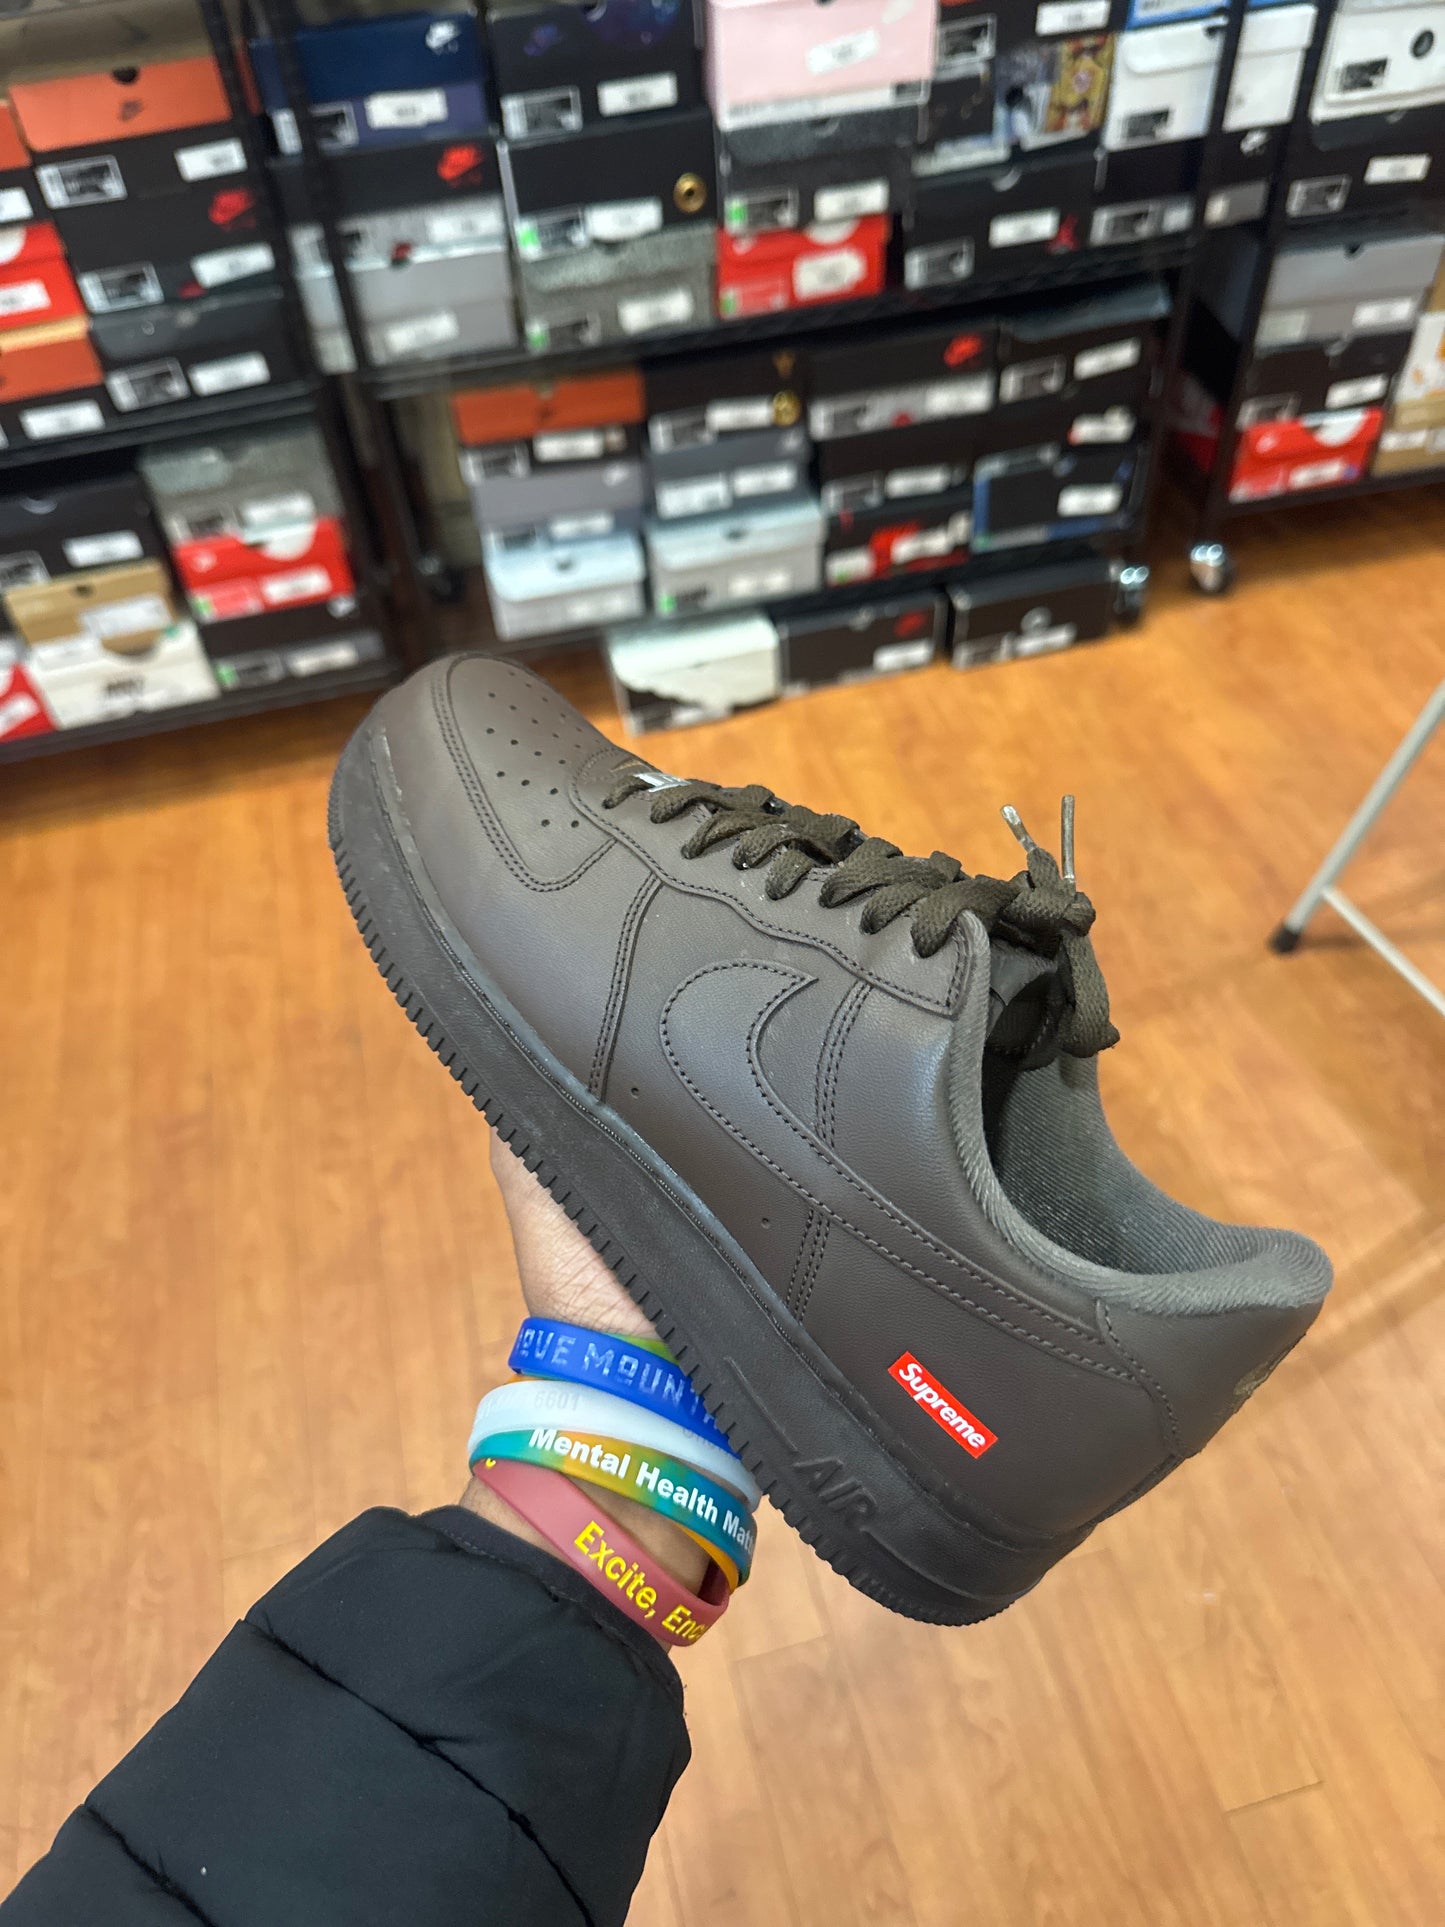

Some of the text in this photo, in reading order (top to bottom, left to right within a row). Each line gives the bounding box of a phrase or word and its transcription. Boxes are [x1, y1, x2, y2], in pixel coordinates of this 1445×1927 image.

[898, 1362, 987, 1450] Supreme
[528, 1427, 632, 1480] Mental
[635, 1461, 719, 1525] Health
[791, 1456, 879, 1528] AIR
[573, 1520, 657, 1619] Excite,
